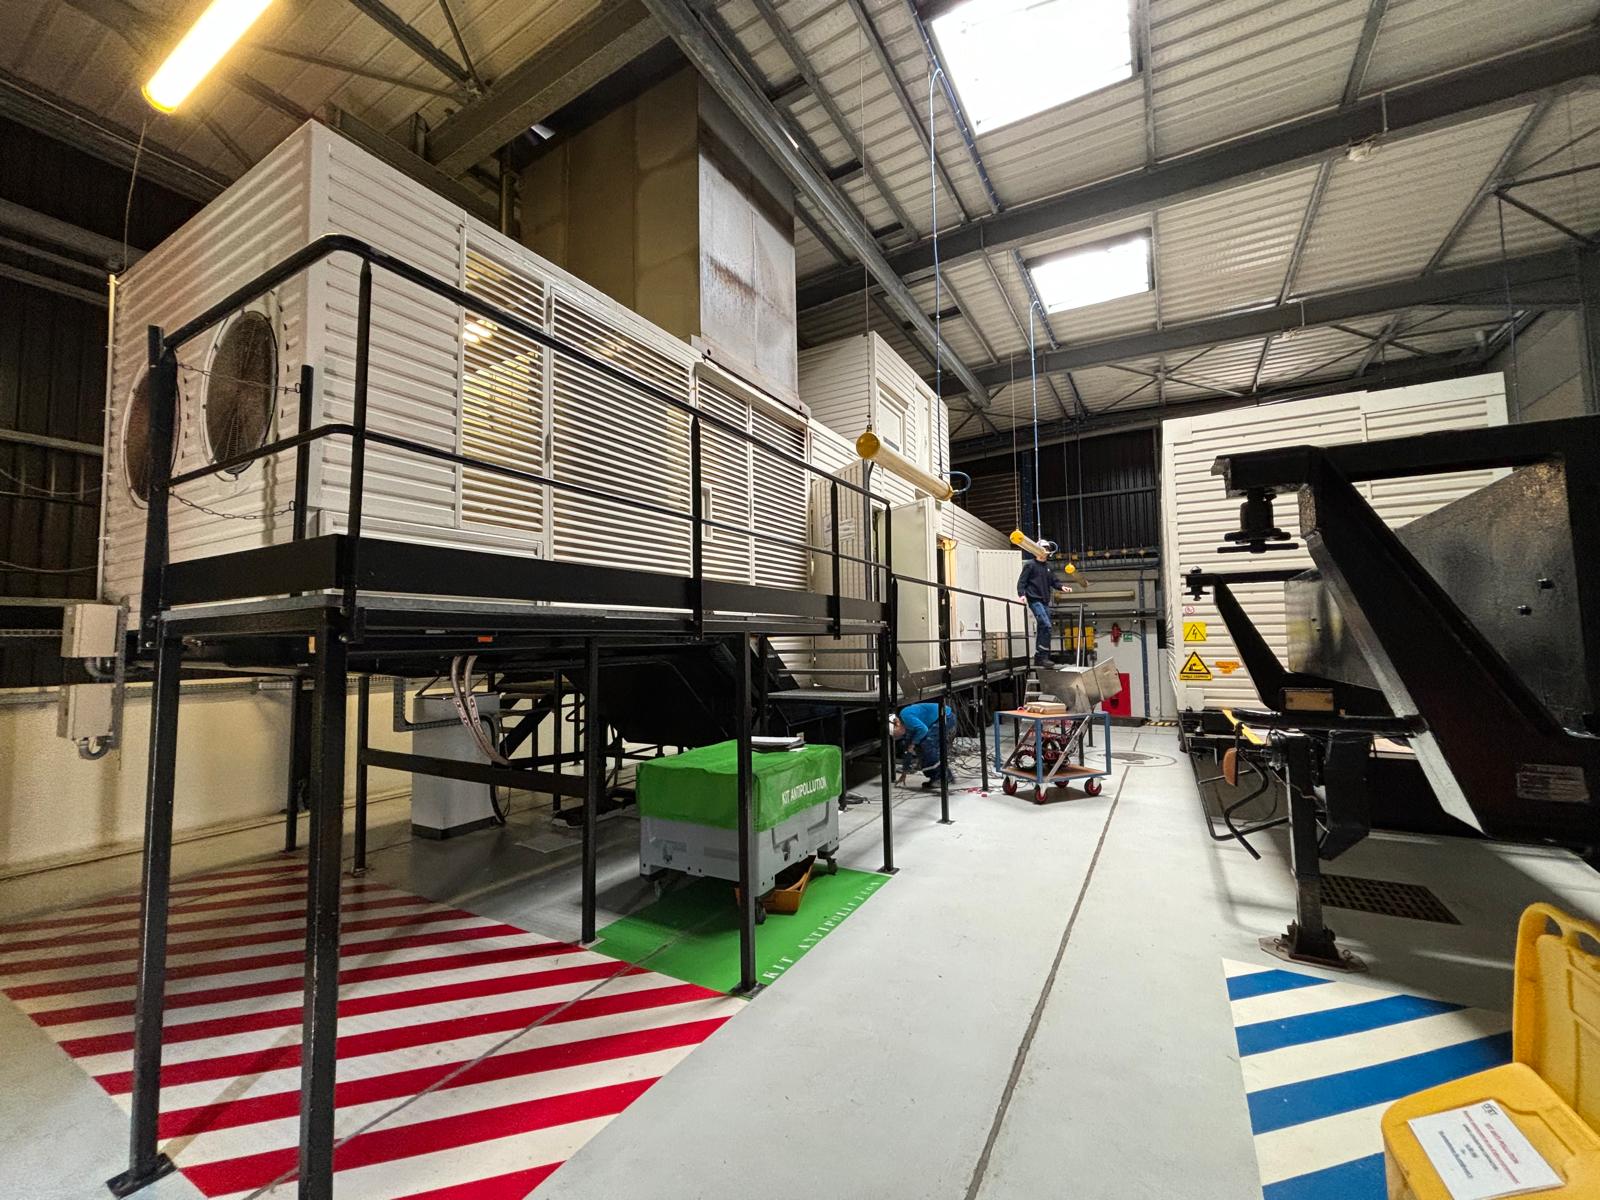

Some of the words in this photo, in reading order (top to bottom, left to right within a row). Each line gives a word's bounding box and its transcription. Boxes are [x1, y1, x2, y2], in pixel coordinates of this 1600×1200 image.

[782, 790, 790, 805] KIT
[791, 776, 827, 801] ANTIPOLLUTION
[762, 956, 793, 979] KIT
